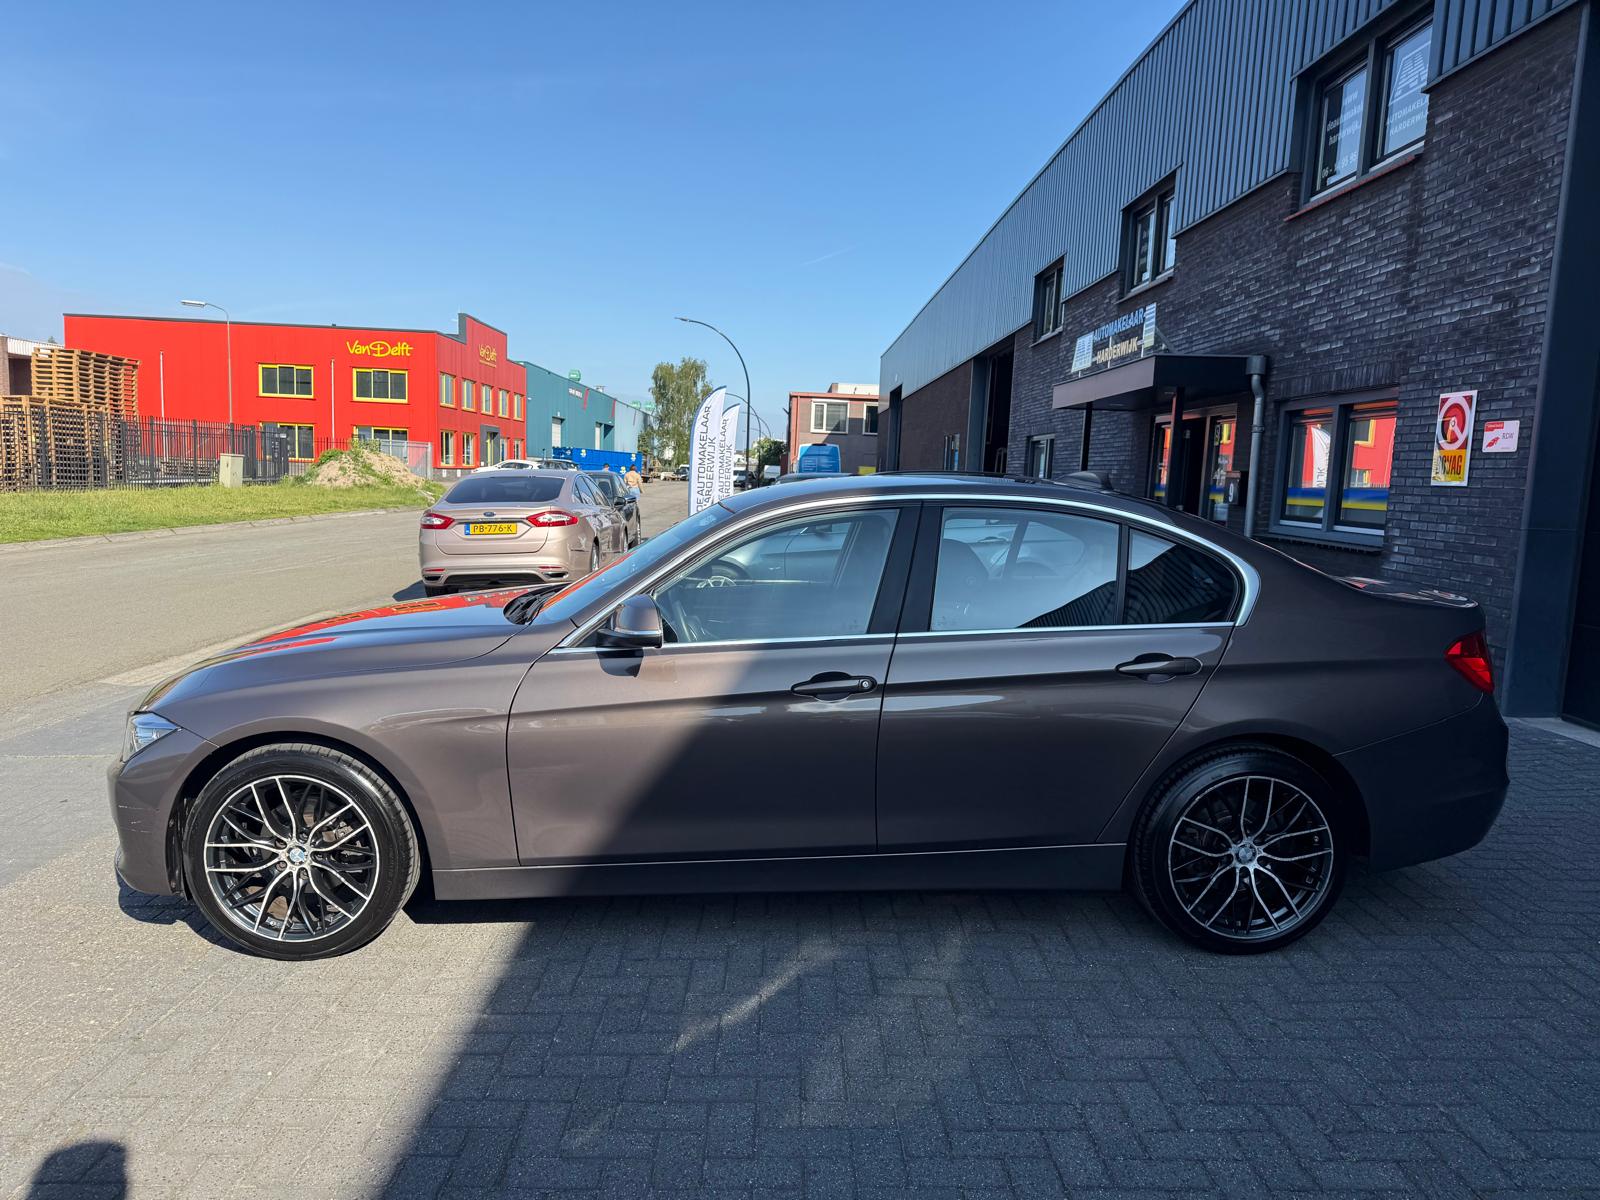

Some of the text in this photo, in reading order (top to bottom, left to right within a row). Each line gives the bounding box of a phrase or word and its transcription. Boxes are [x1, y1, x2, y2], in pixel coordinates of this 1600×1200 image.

[1096, 336, 1139, 365] HARDERWIJK
[697, 405, 712, 495] AUTOMAKELAAR
[704, 436, 716, 505] ARDERWIJK
[718, 418, 729, 494] AUTOMAKELAAR
[1228, 482, 1235, 502] 9
[473, 525, 513, 533] PB-776-K
